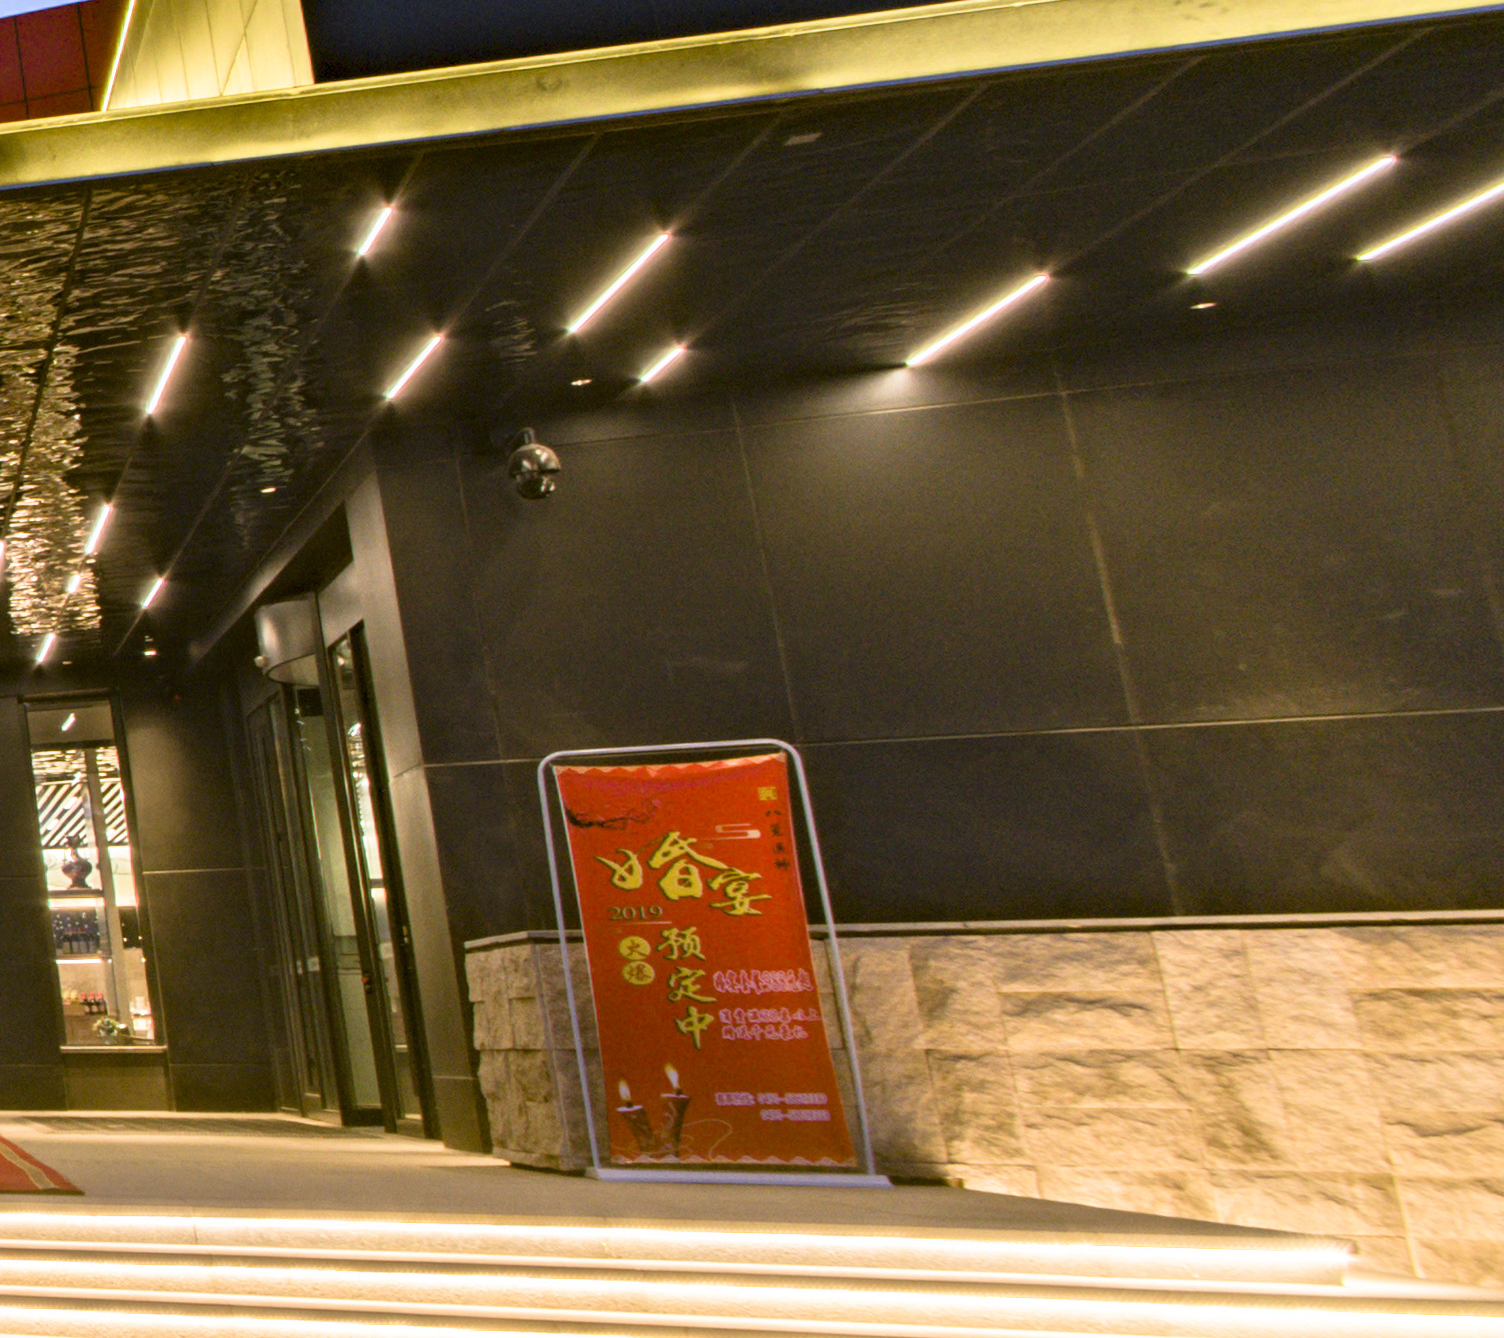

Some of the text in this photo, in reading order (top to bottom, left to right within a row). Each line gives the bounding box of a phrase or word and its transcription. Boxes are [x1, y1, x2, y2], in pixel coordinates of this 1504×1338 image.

[593, 830, 773, 917] 婚宴
[608, 905, 663, 921] 2019
[656, 926, 717, 1051] 预定中
